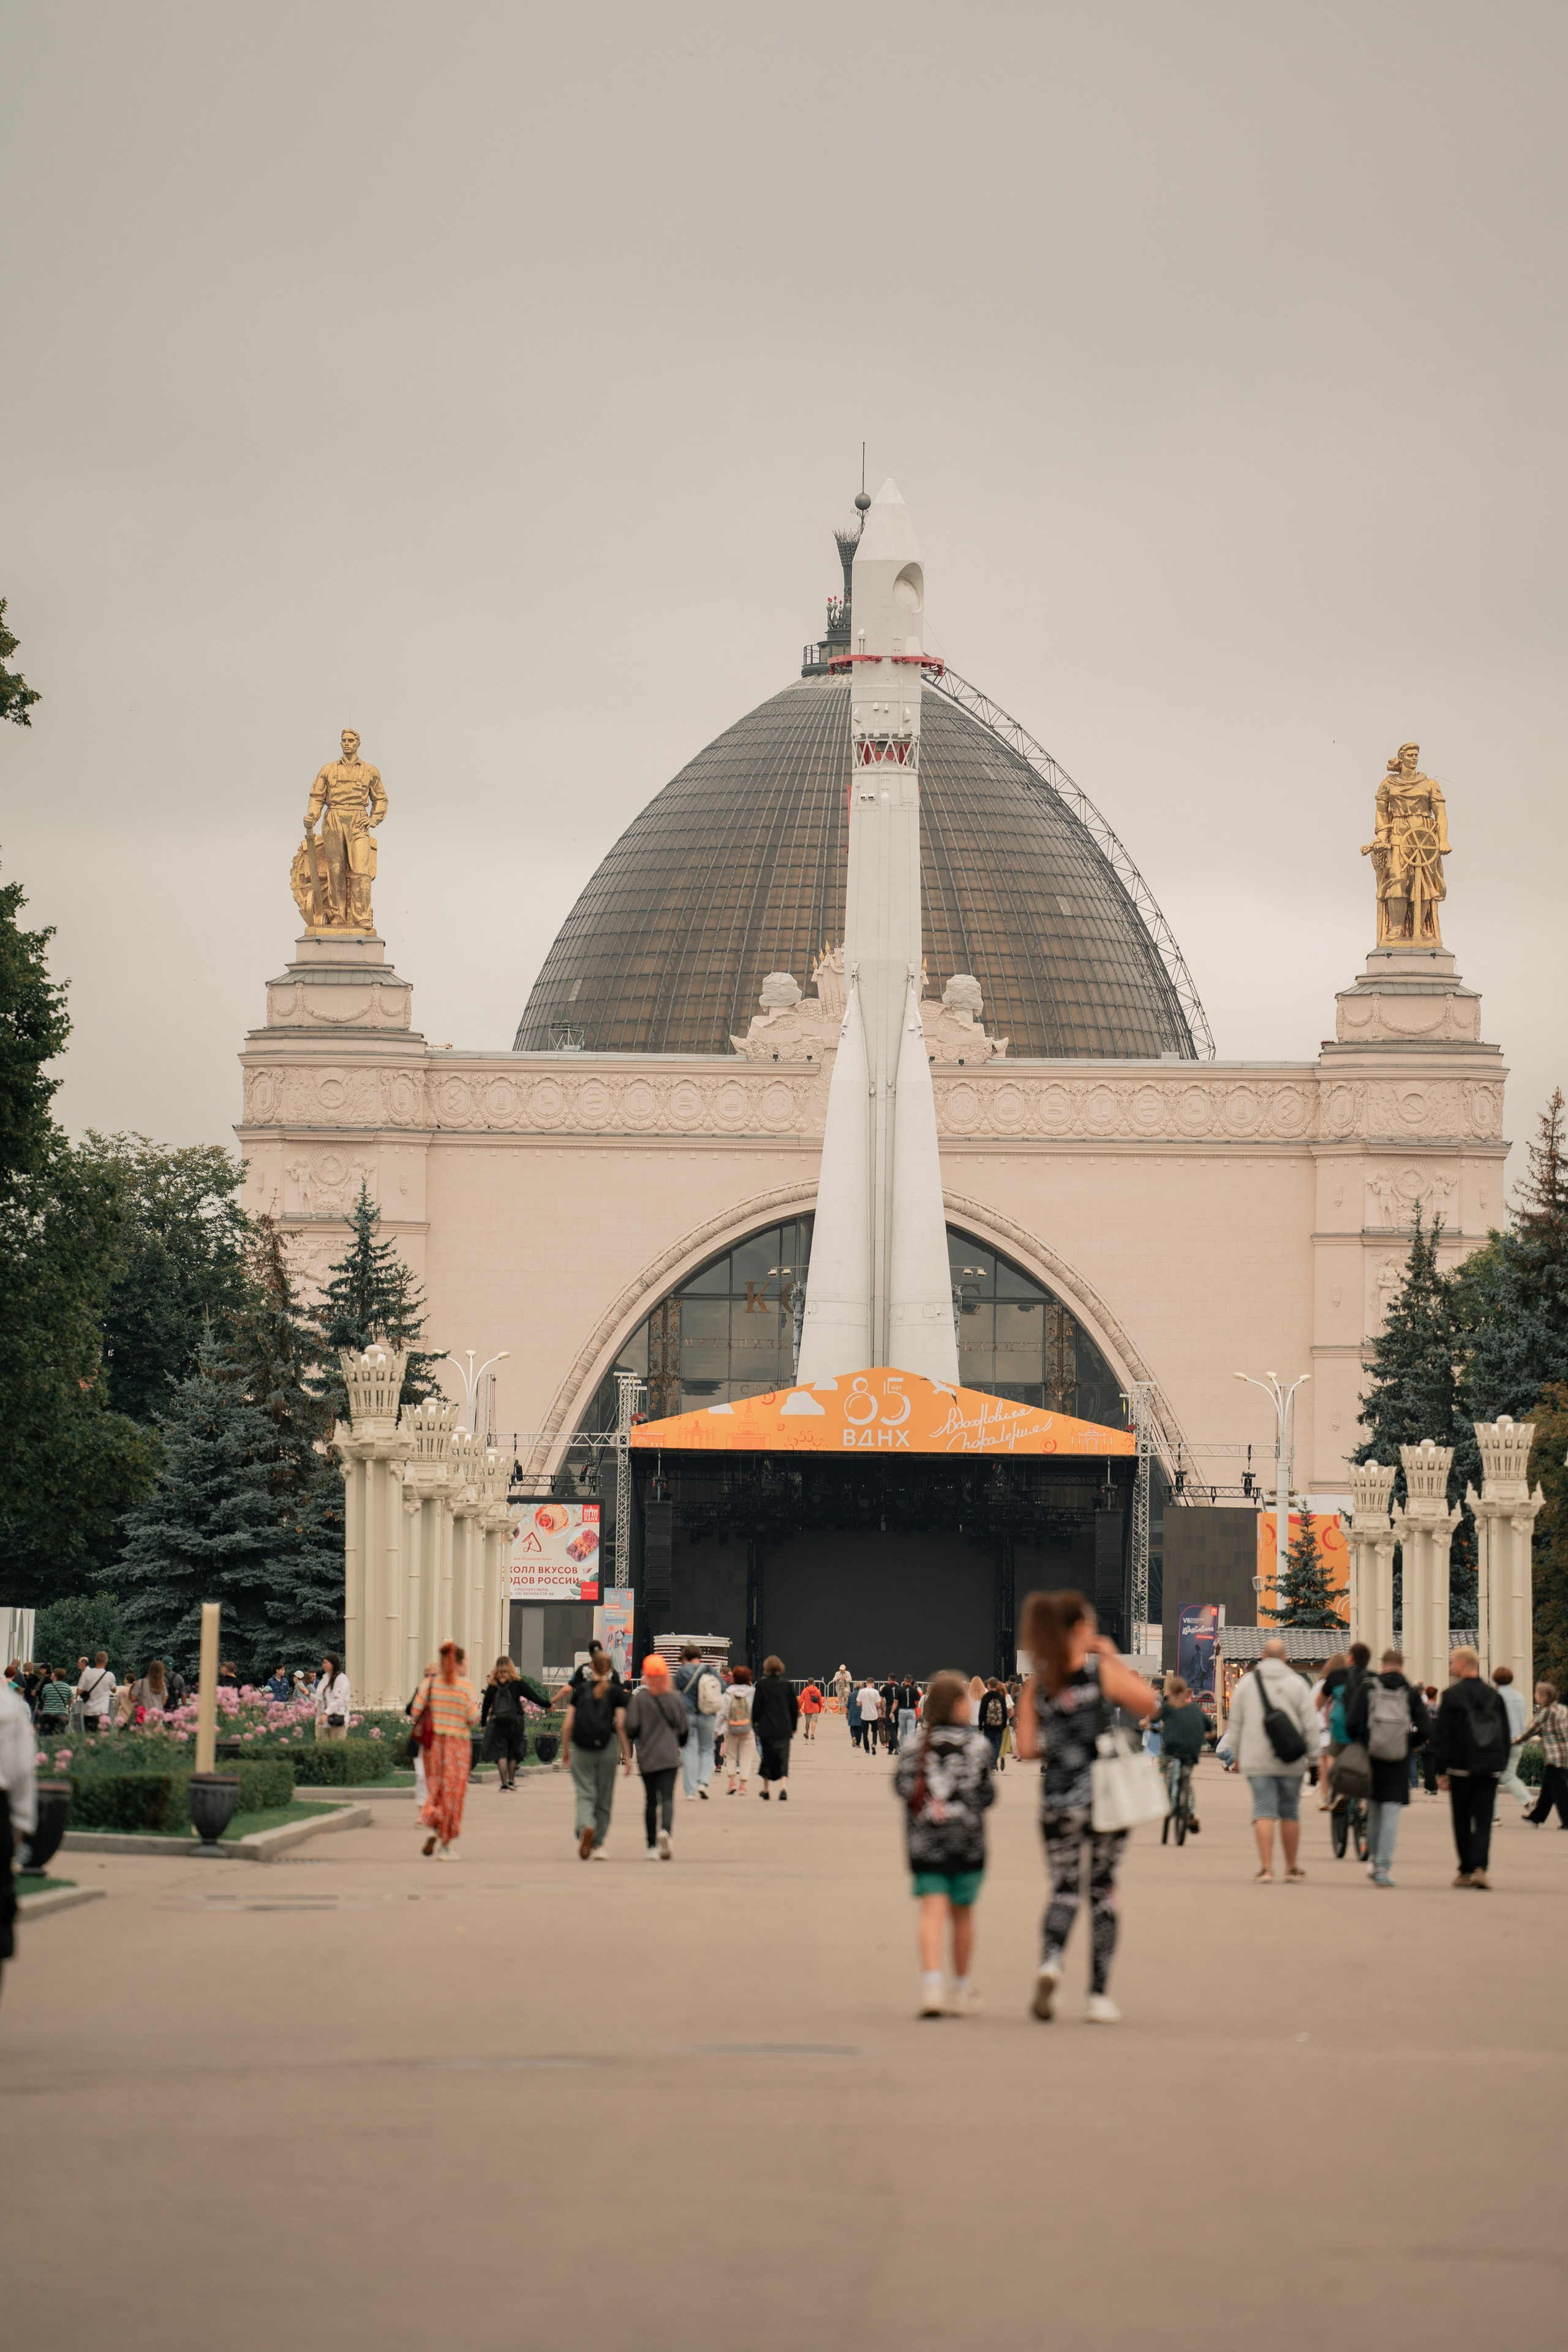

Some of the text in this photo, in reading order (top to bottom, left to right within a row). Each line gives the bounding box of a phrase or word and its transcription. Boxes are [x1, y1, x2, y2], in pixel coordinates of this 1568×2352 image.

[684, 1338, 789, 1349] МЕХАНИЗА
[844, 1377, 911, 1426] 85
[843, 1429, 910, 1447] ВДНХ
